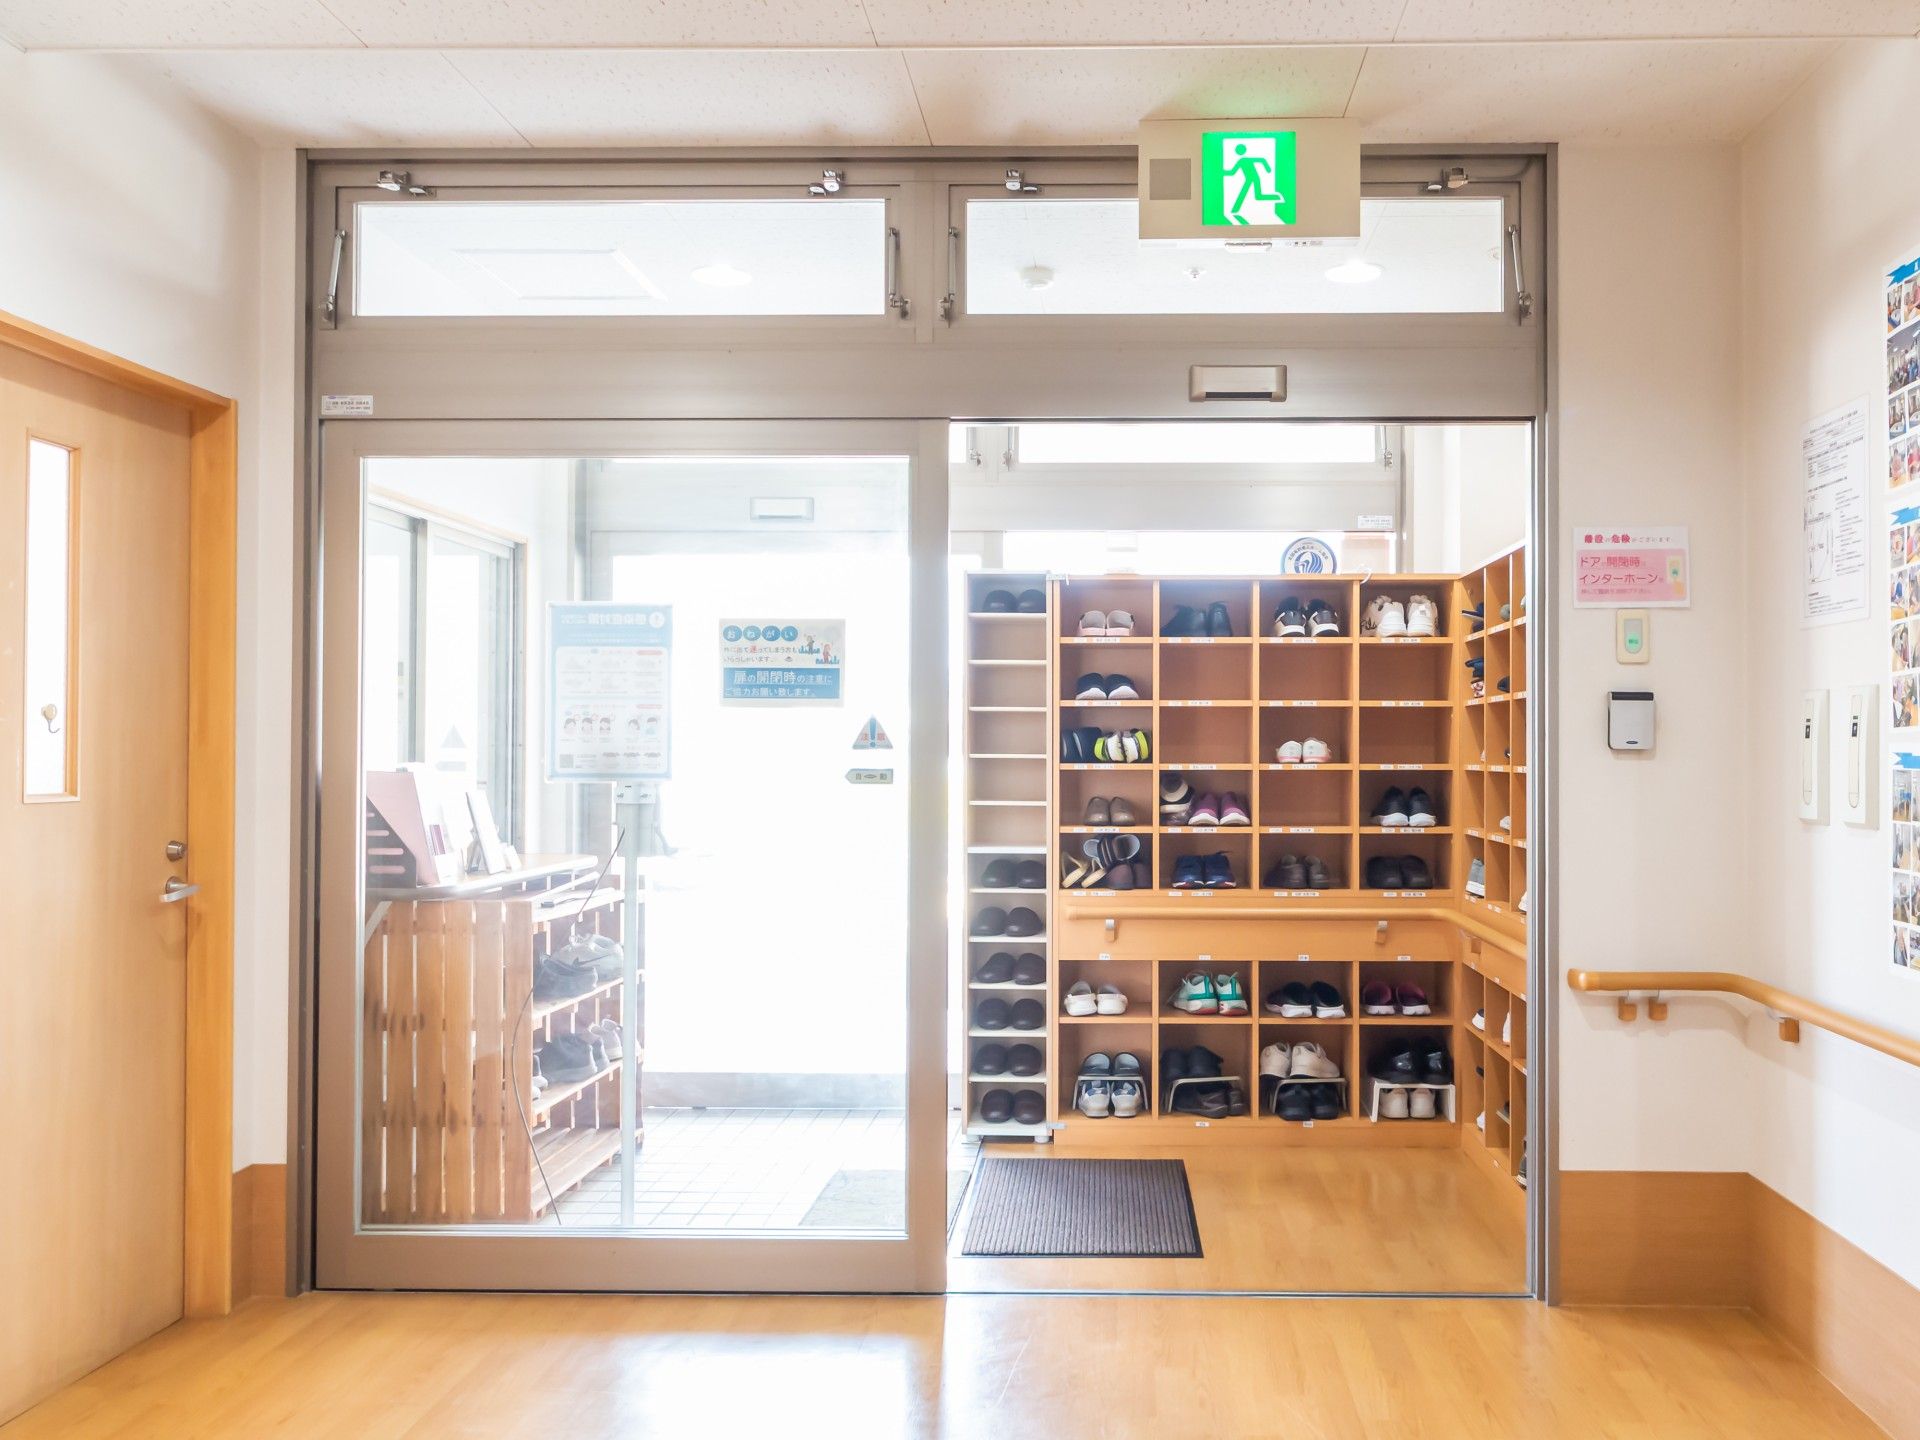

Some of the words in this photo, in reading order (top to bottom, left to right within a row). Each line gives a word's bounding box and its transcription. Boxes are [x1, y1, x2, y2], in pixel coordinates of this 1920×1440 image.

[726, 629, 794, 640] おねがい
[734, 670, 833, 685] 扉の開閉時の注意に
